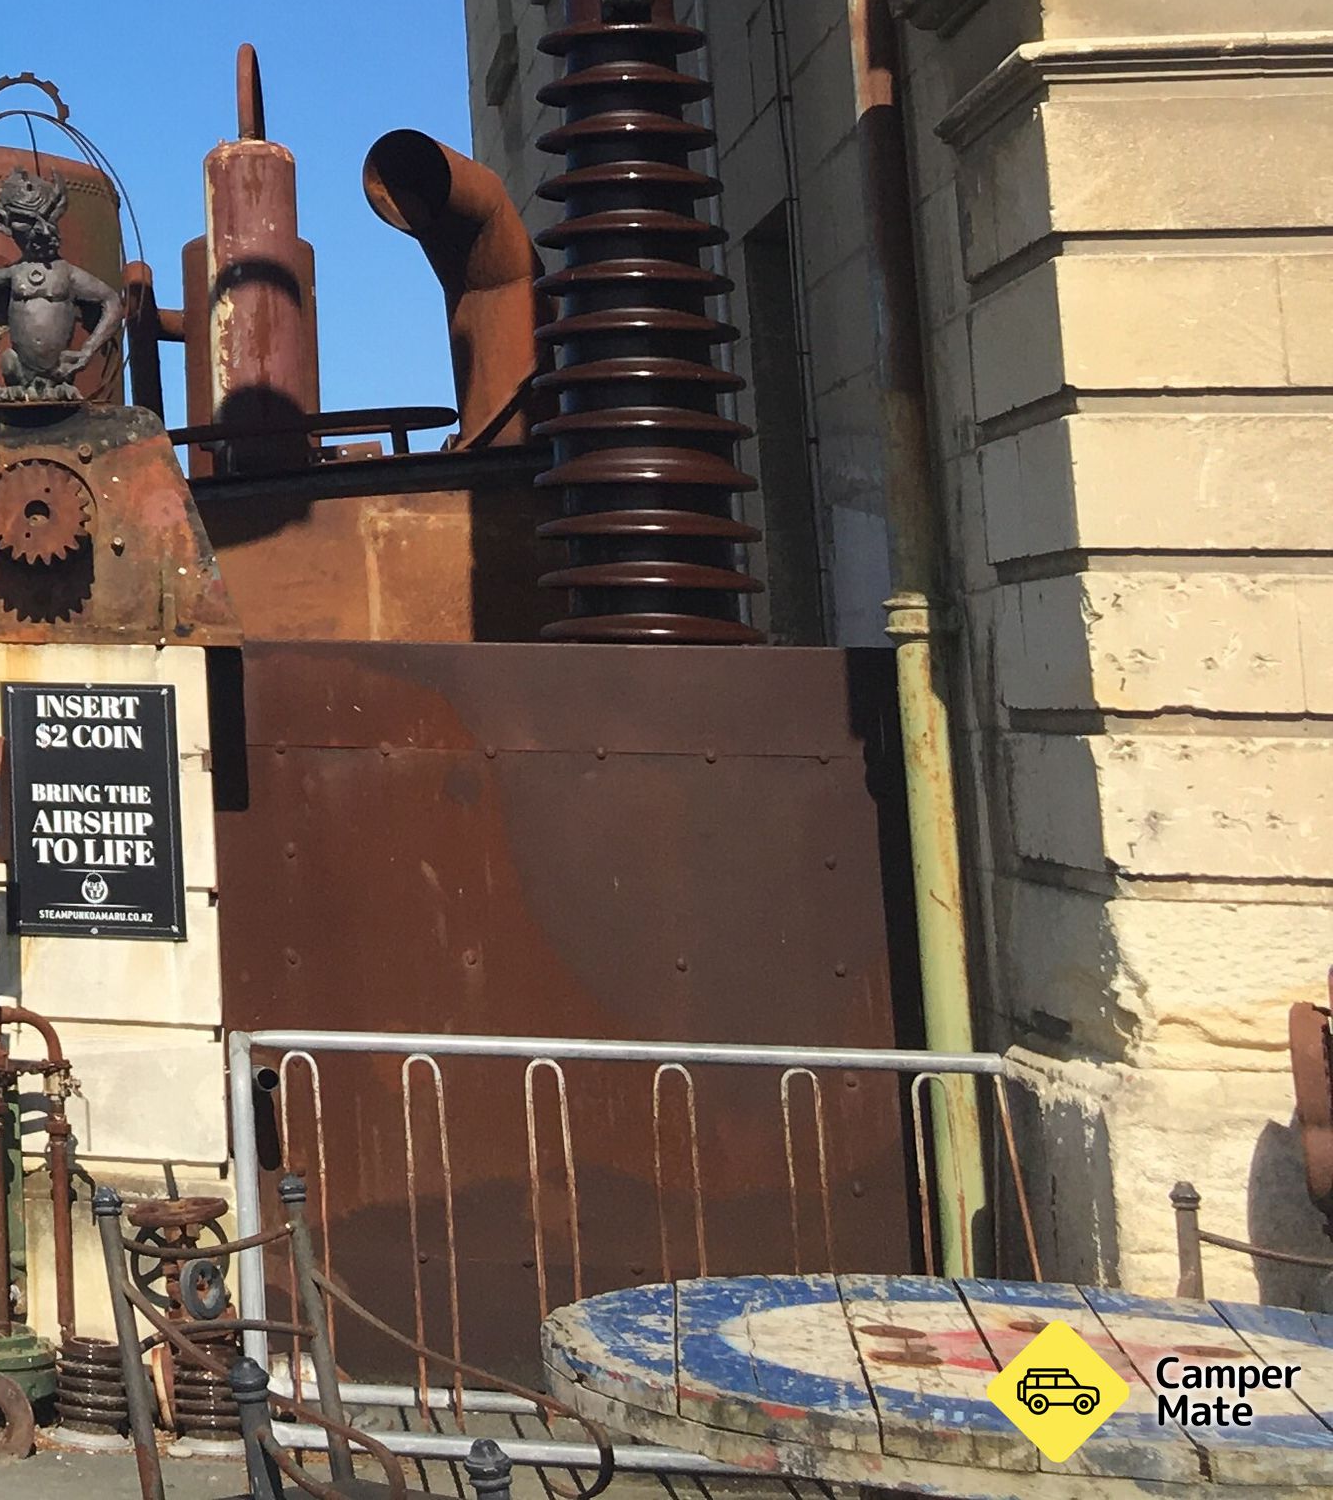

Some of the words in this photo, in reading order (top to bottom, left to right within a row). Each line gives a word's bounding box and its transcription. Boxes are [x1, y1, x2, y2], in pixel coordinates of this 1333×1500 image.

[36, 694, 139, 720] INSERT
[35, 723, 68, 749] $2
[71, 724, 143, 750] COIN
[31, 783, 101, 804] BRING
[104, 784, 152, 805] THE
[31, 809, 154, 836] AIRSHIP
[31, 837, 79, 865] TO
[83, 838, 155, 867] LIFE
[38, 909, 153, 923] STEAMPUNKOAMARU.CO.NZ
